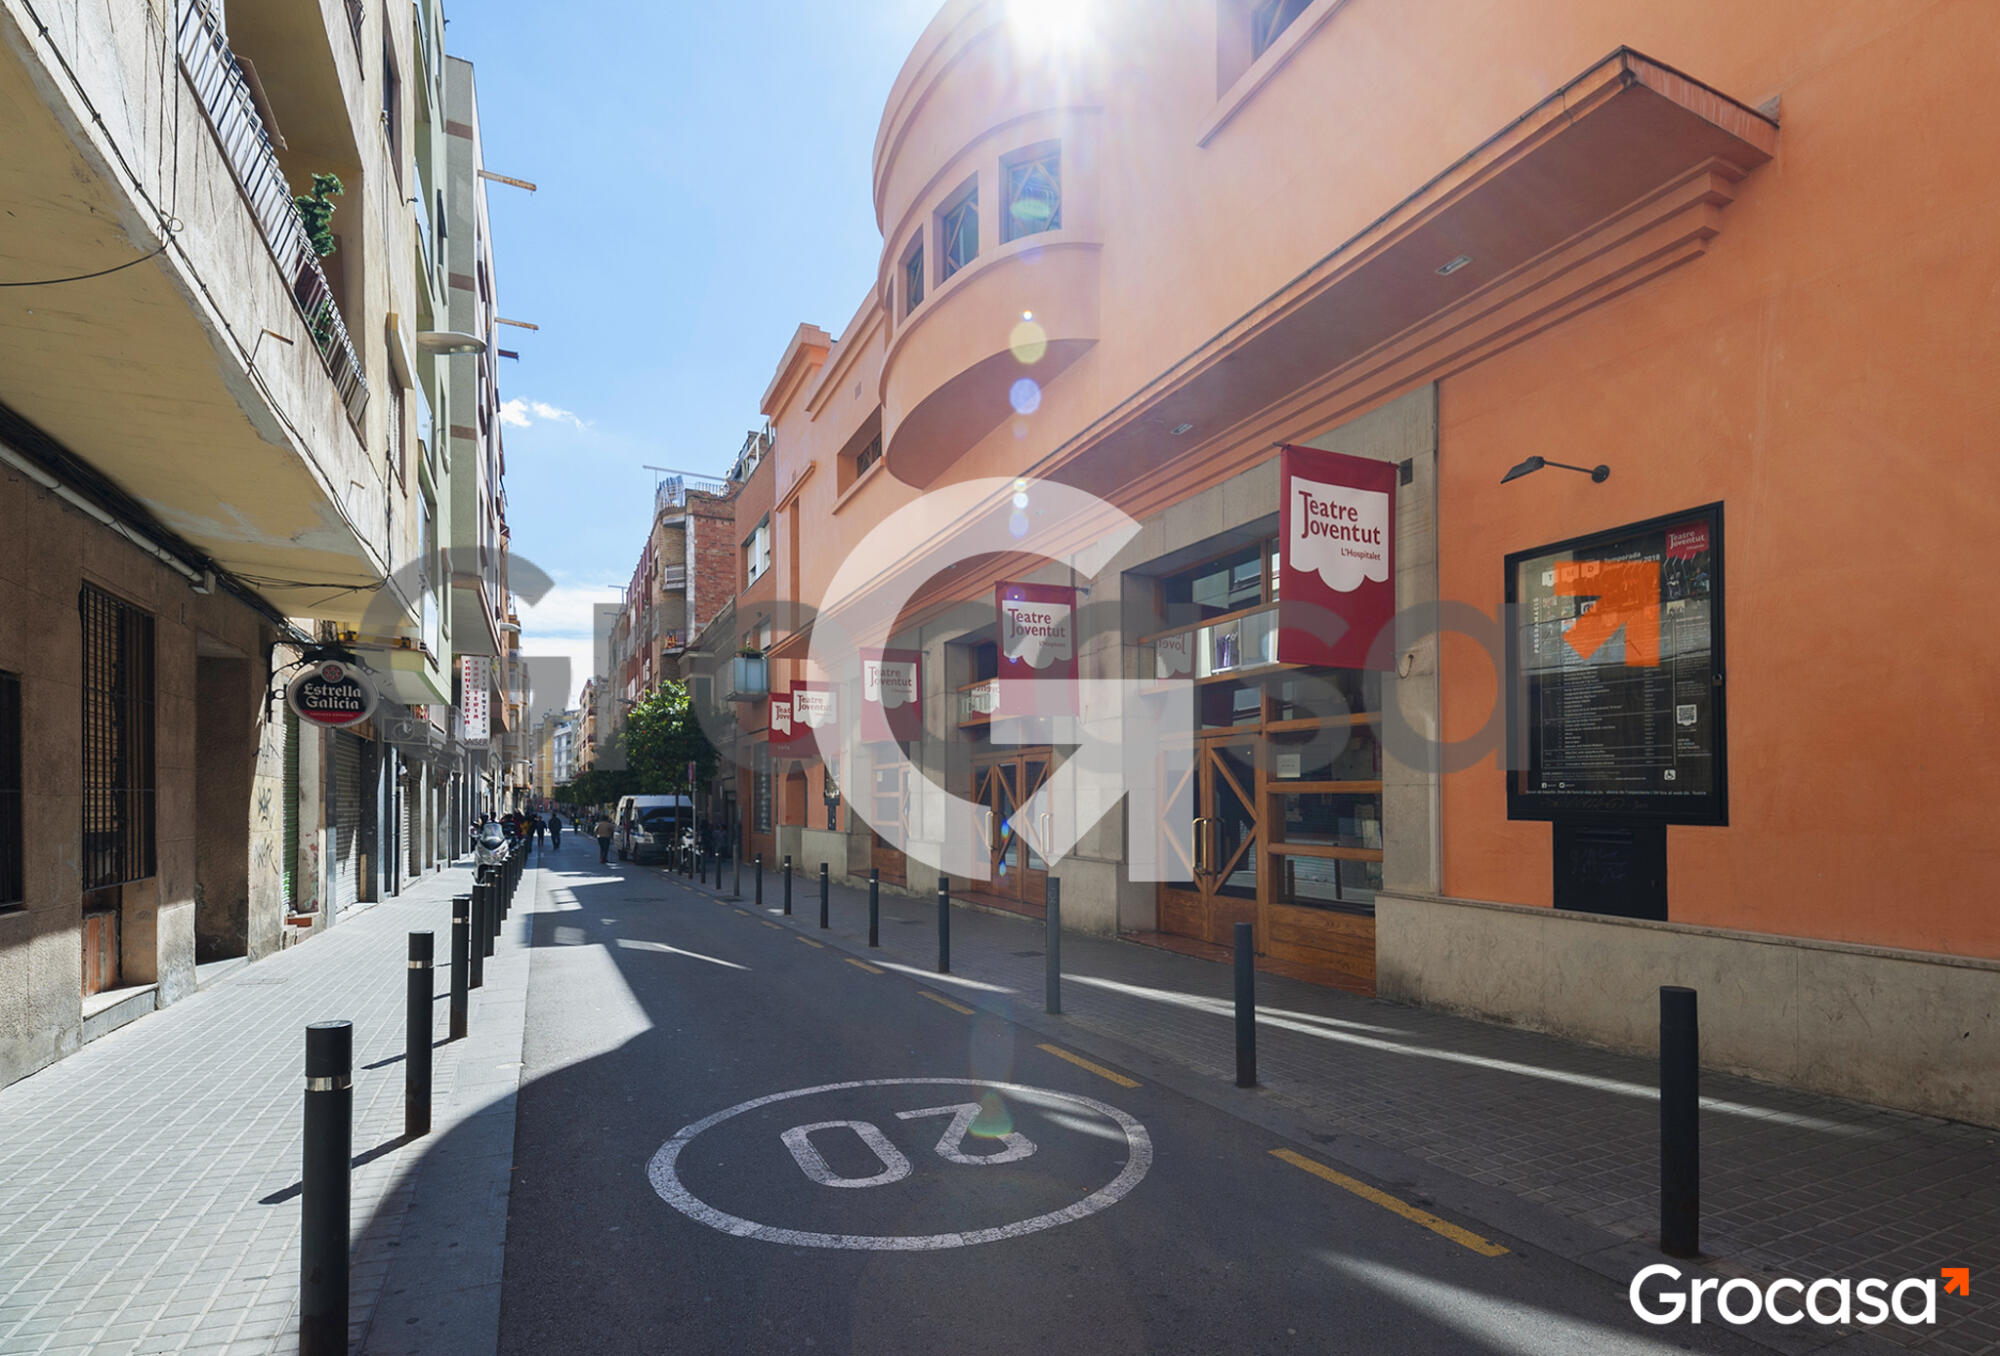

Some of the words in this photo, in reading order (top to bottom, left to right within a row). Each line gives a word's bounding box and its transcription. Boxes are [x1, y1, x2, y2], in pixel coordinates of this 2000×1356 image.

[1298, 490, 1359, 522] Teatre
[1301, 517, 1381, 546] Joventut
[1668, 531, 1696, 545] Teatre
[1340, 547, 1381, 561] L'Hospitalet
[1007, 608, 1052, 625] Teatre
[1009, 623, 1066, 638] Joventut
[868, 666, 902, 678] Teatre
[870, 676, 913, 688] Joventut
[303, 683, 361, 698] Estrella
[306, 696, 359, 710] Galicia
[797, 695, 825, 704] Teatre
